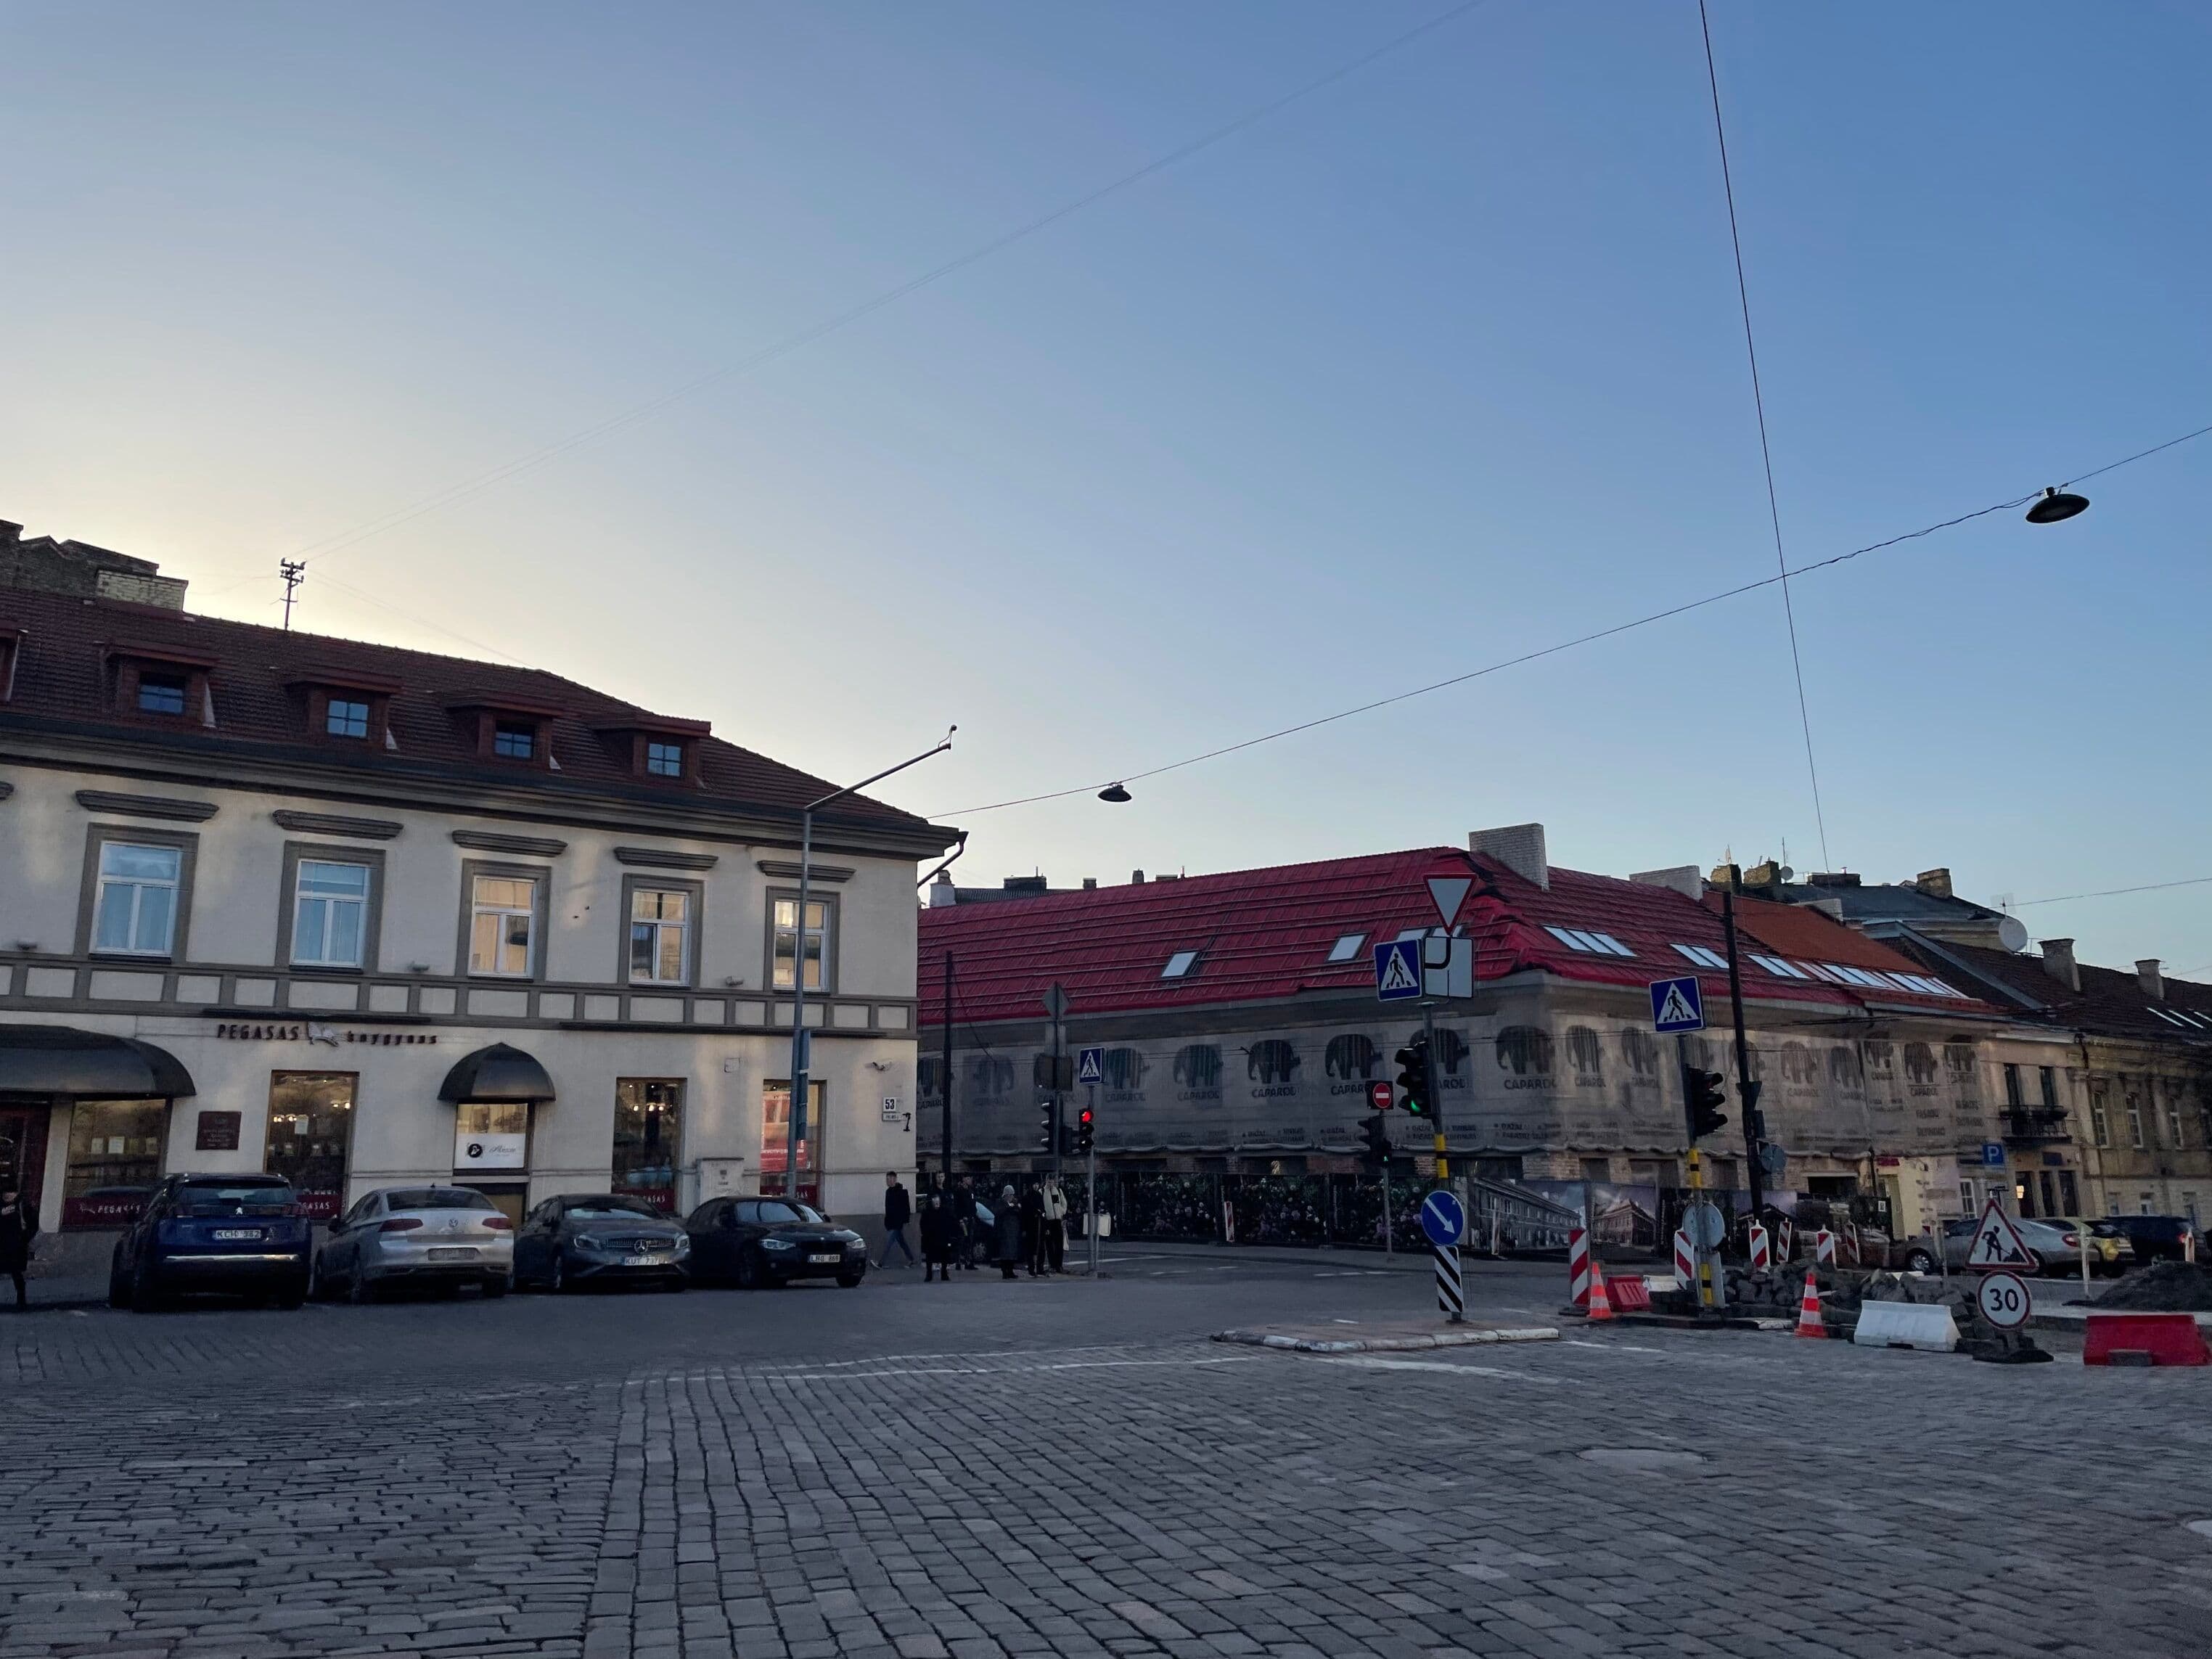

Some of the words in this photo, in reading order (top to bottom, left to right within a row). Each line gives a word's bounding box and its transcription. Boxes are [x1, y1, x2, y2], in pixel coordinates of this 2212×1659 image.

[217, 1024, 299, 1041] PEGASAS
[885, 1099, 895, 1110] 53
[1988, 1146, 1999, 1163] P
[1989, 1288, 2019, 1312] 30
